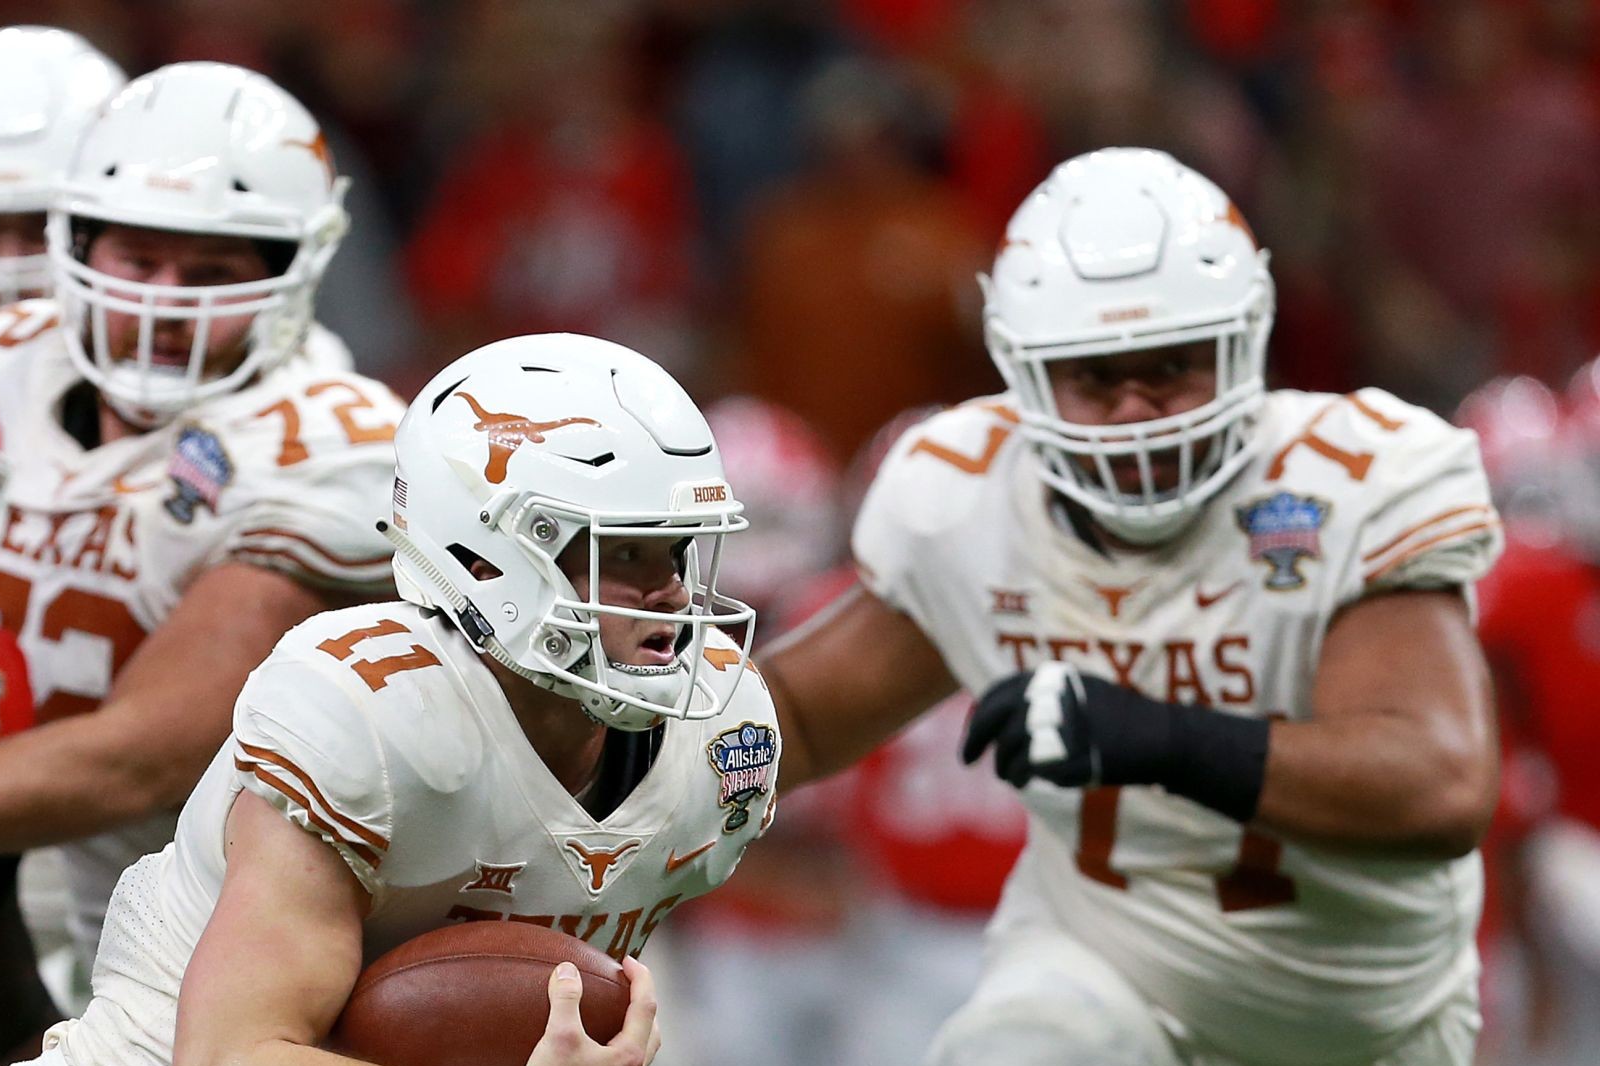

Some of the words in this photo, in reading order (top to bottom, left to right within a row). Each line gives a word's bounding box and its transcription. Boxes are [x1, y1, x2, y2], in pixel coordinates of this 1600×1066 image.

[254, 379, 397, 467] 72
[693, 485, 726, 503] HORNS
[315, 618, 443, 693] 11
[725, 746, 771, 770] Allstate
